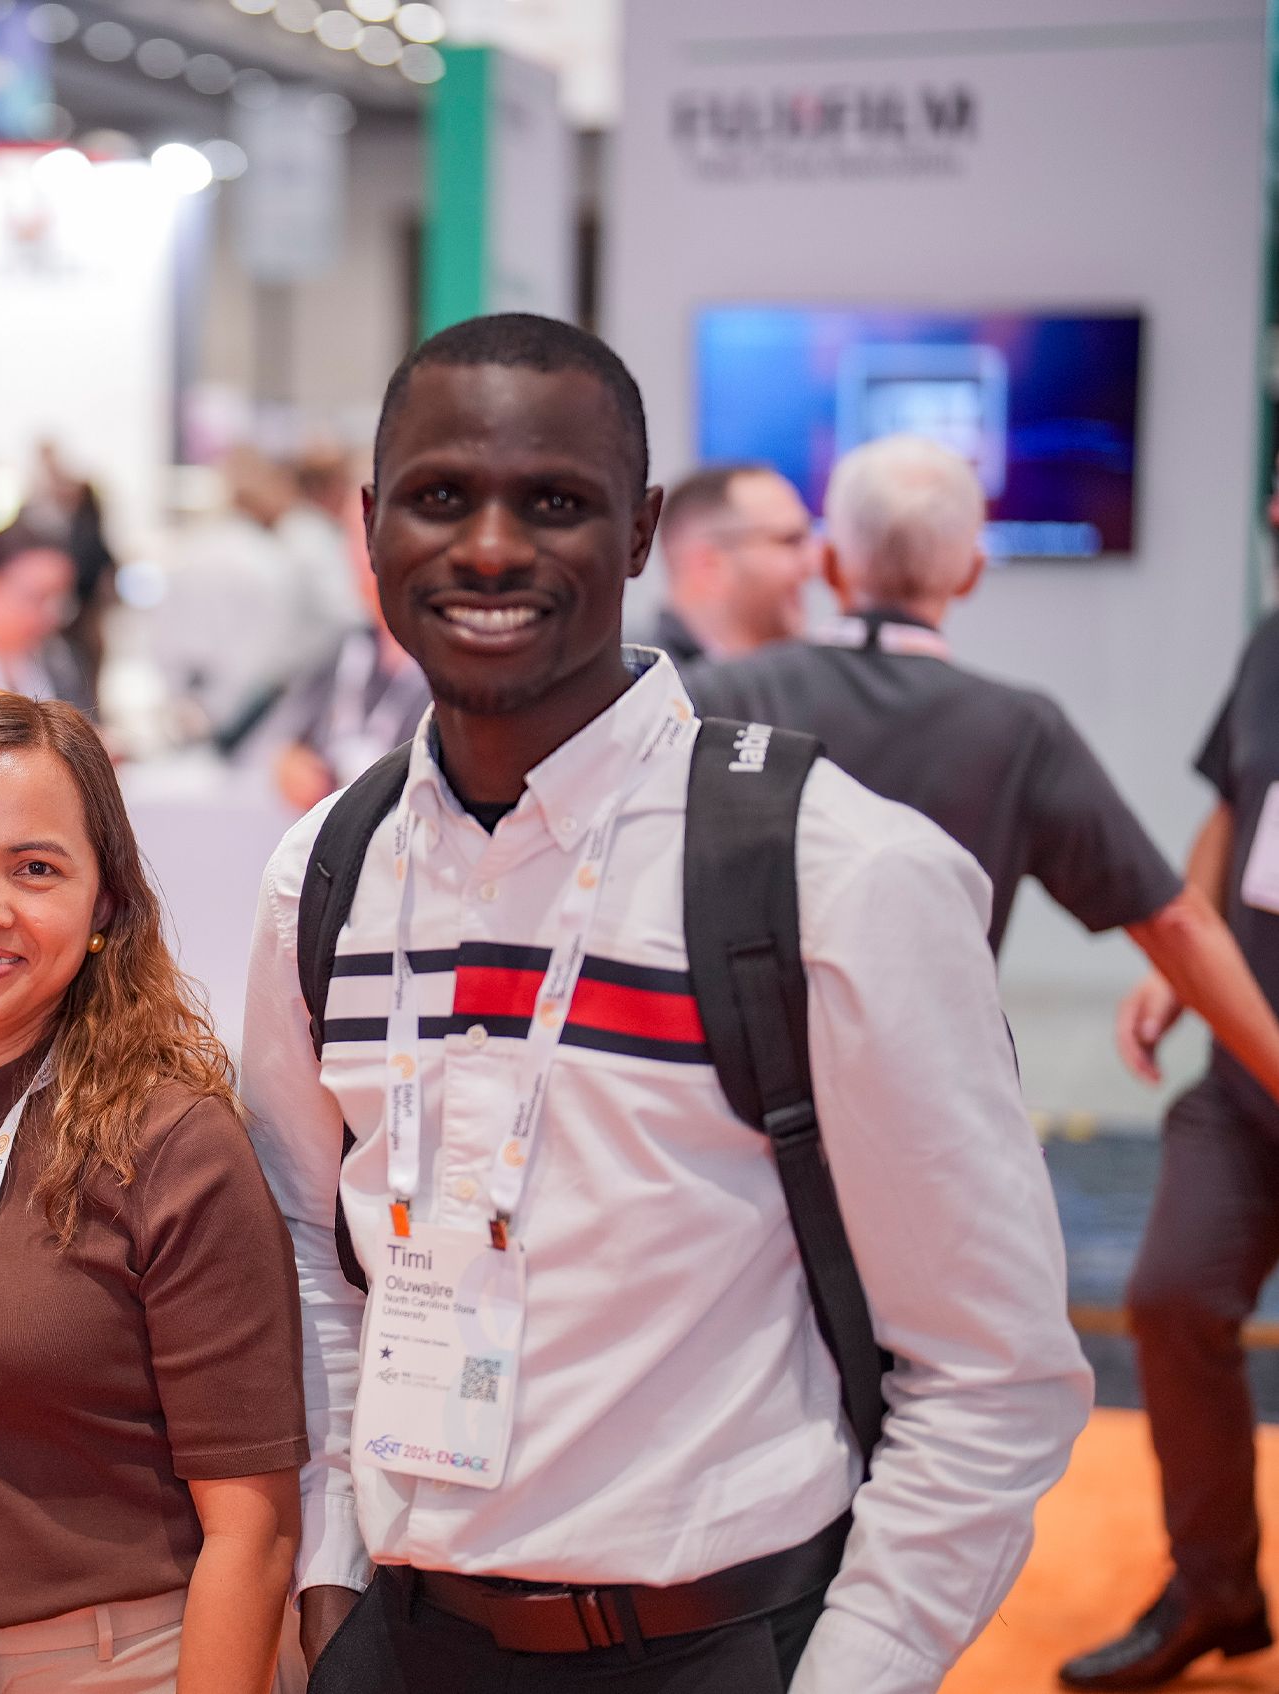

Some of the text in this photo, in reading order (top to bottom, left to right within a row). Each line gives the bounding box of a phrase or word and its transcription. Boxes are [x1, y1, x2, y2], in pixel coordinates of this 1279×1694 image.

[386, 1244, 433, 1271] Timi
[385, 1275, 453, 1299] Oluwajire
[384, 1293, 409, 1305] North
[411, 1296, 450, 1311] Carolina
[382, 1305, 427, 1322] University
